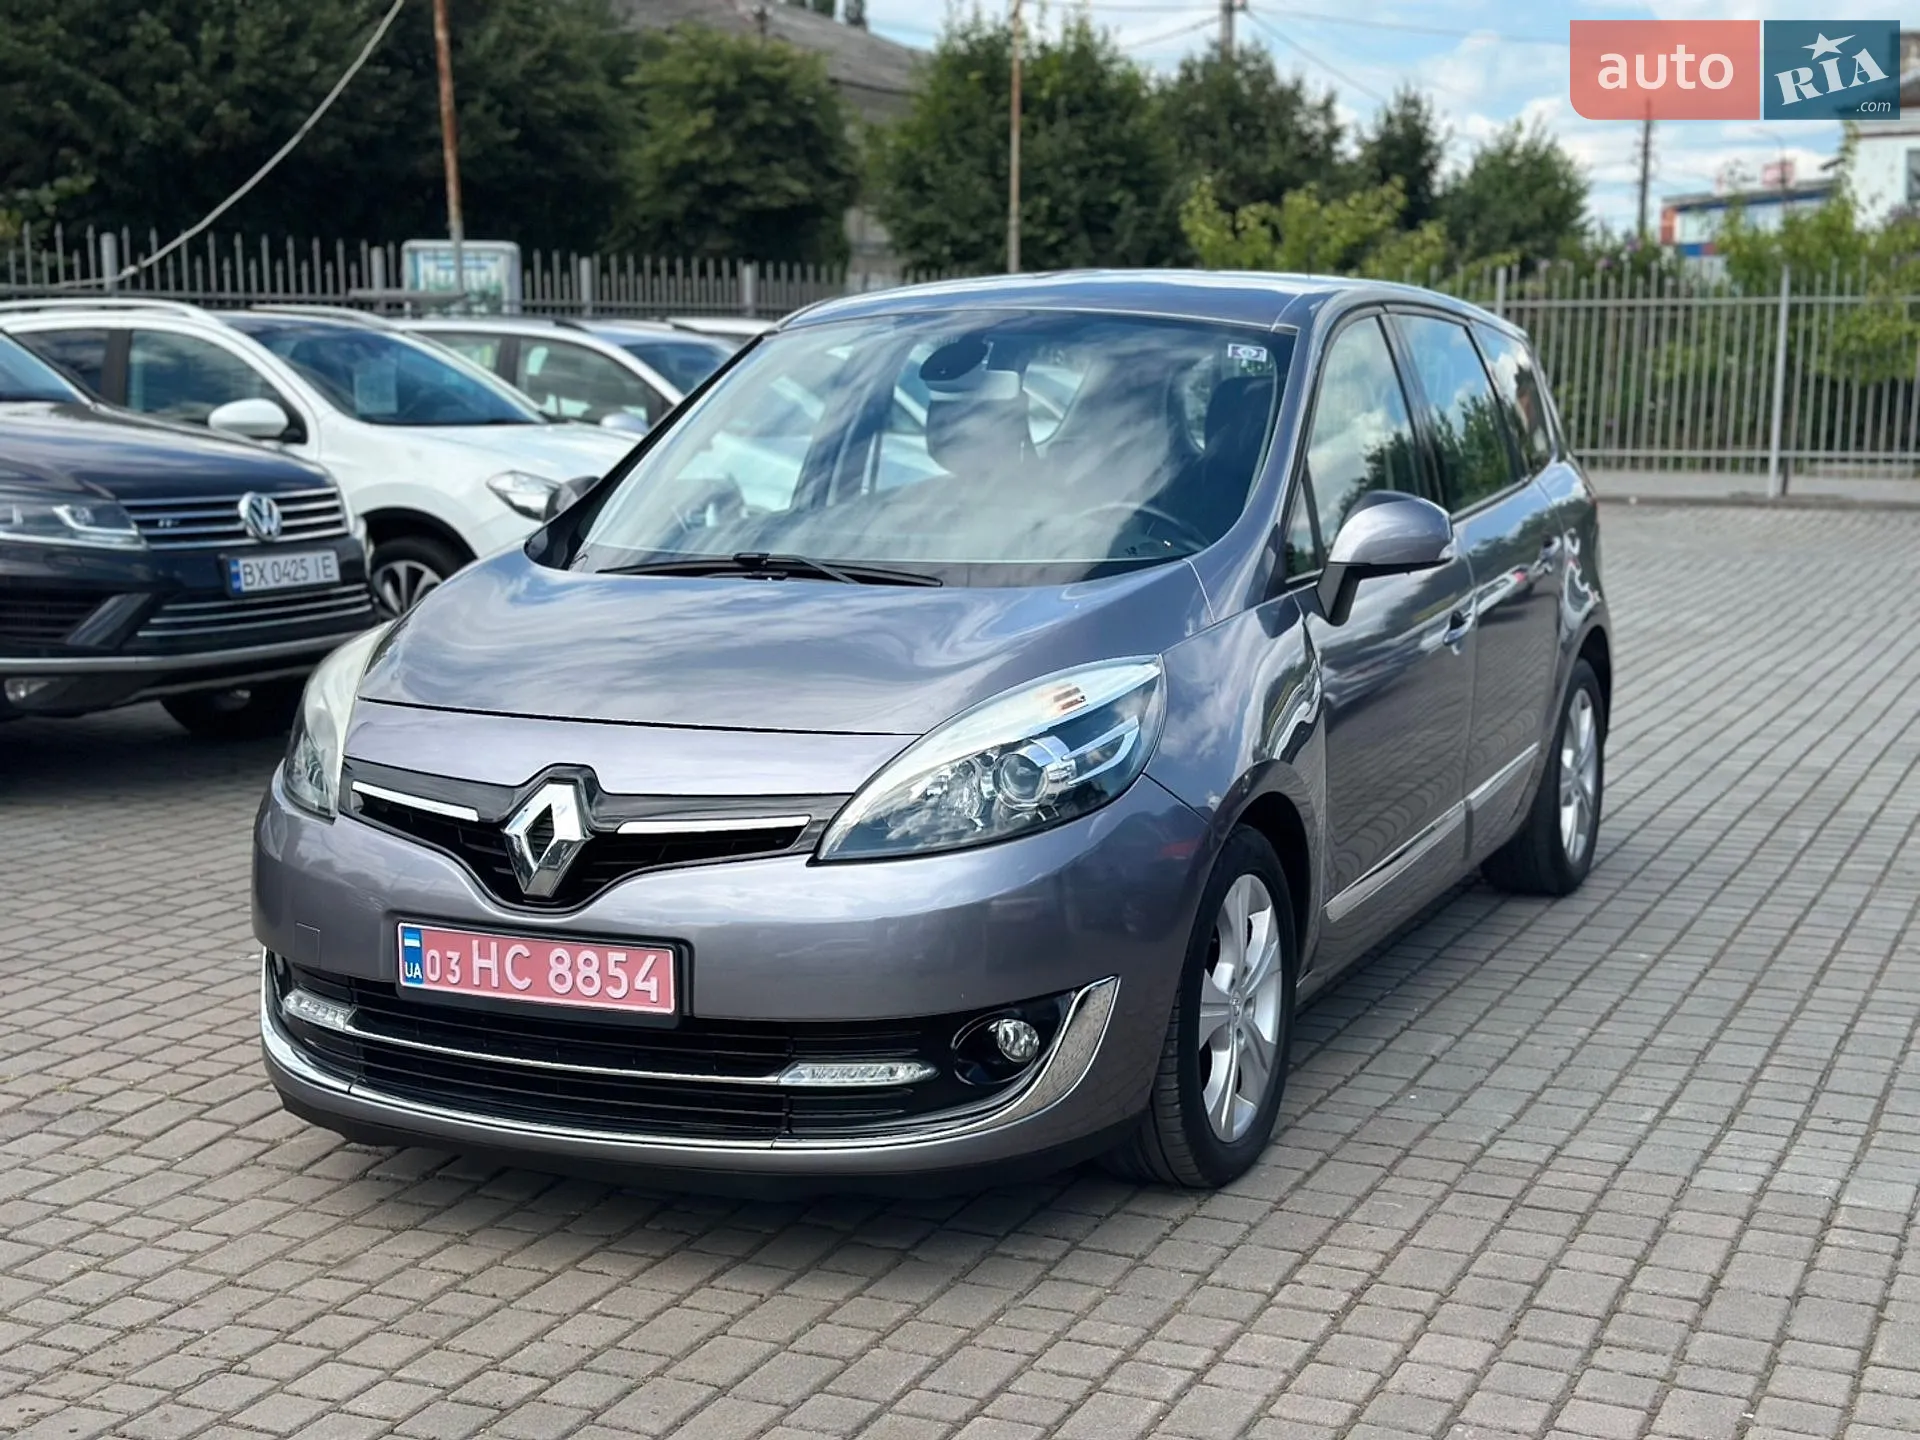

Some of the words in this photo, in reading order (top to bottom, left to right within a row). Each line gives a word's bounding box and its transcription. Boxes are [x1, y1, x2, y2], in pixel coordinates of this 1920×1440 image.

[242, 563, 269, 587] BX
[271, 558, 310, 583] 0425
[314, 555, 334, 580] IE
[405, 961, 423, 980] UA
[426, 948, 462, 984] 03
[471, 939, 532, 991] HC
[548, 946, 659, 1003] 8854
